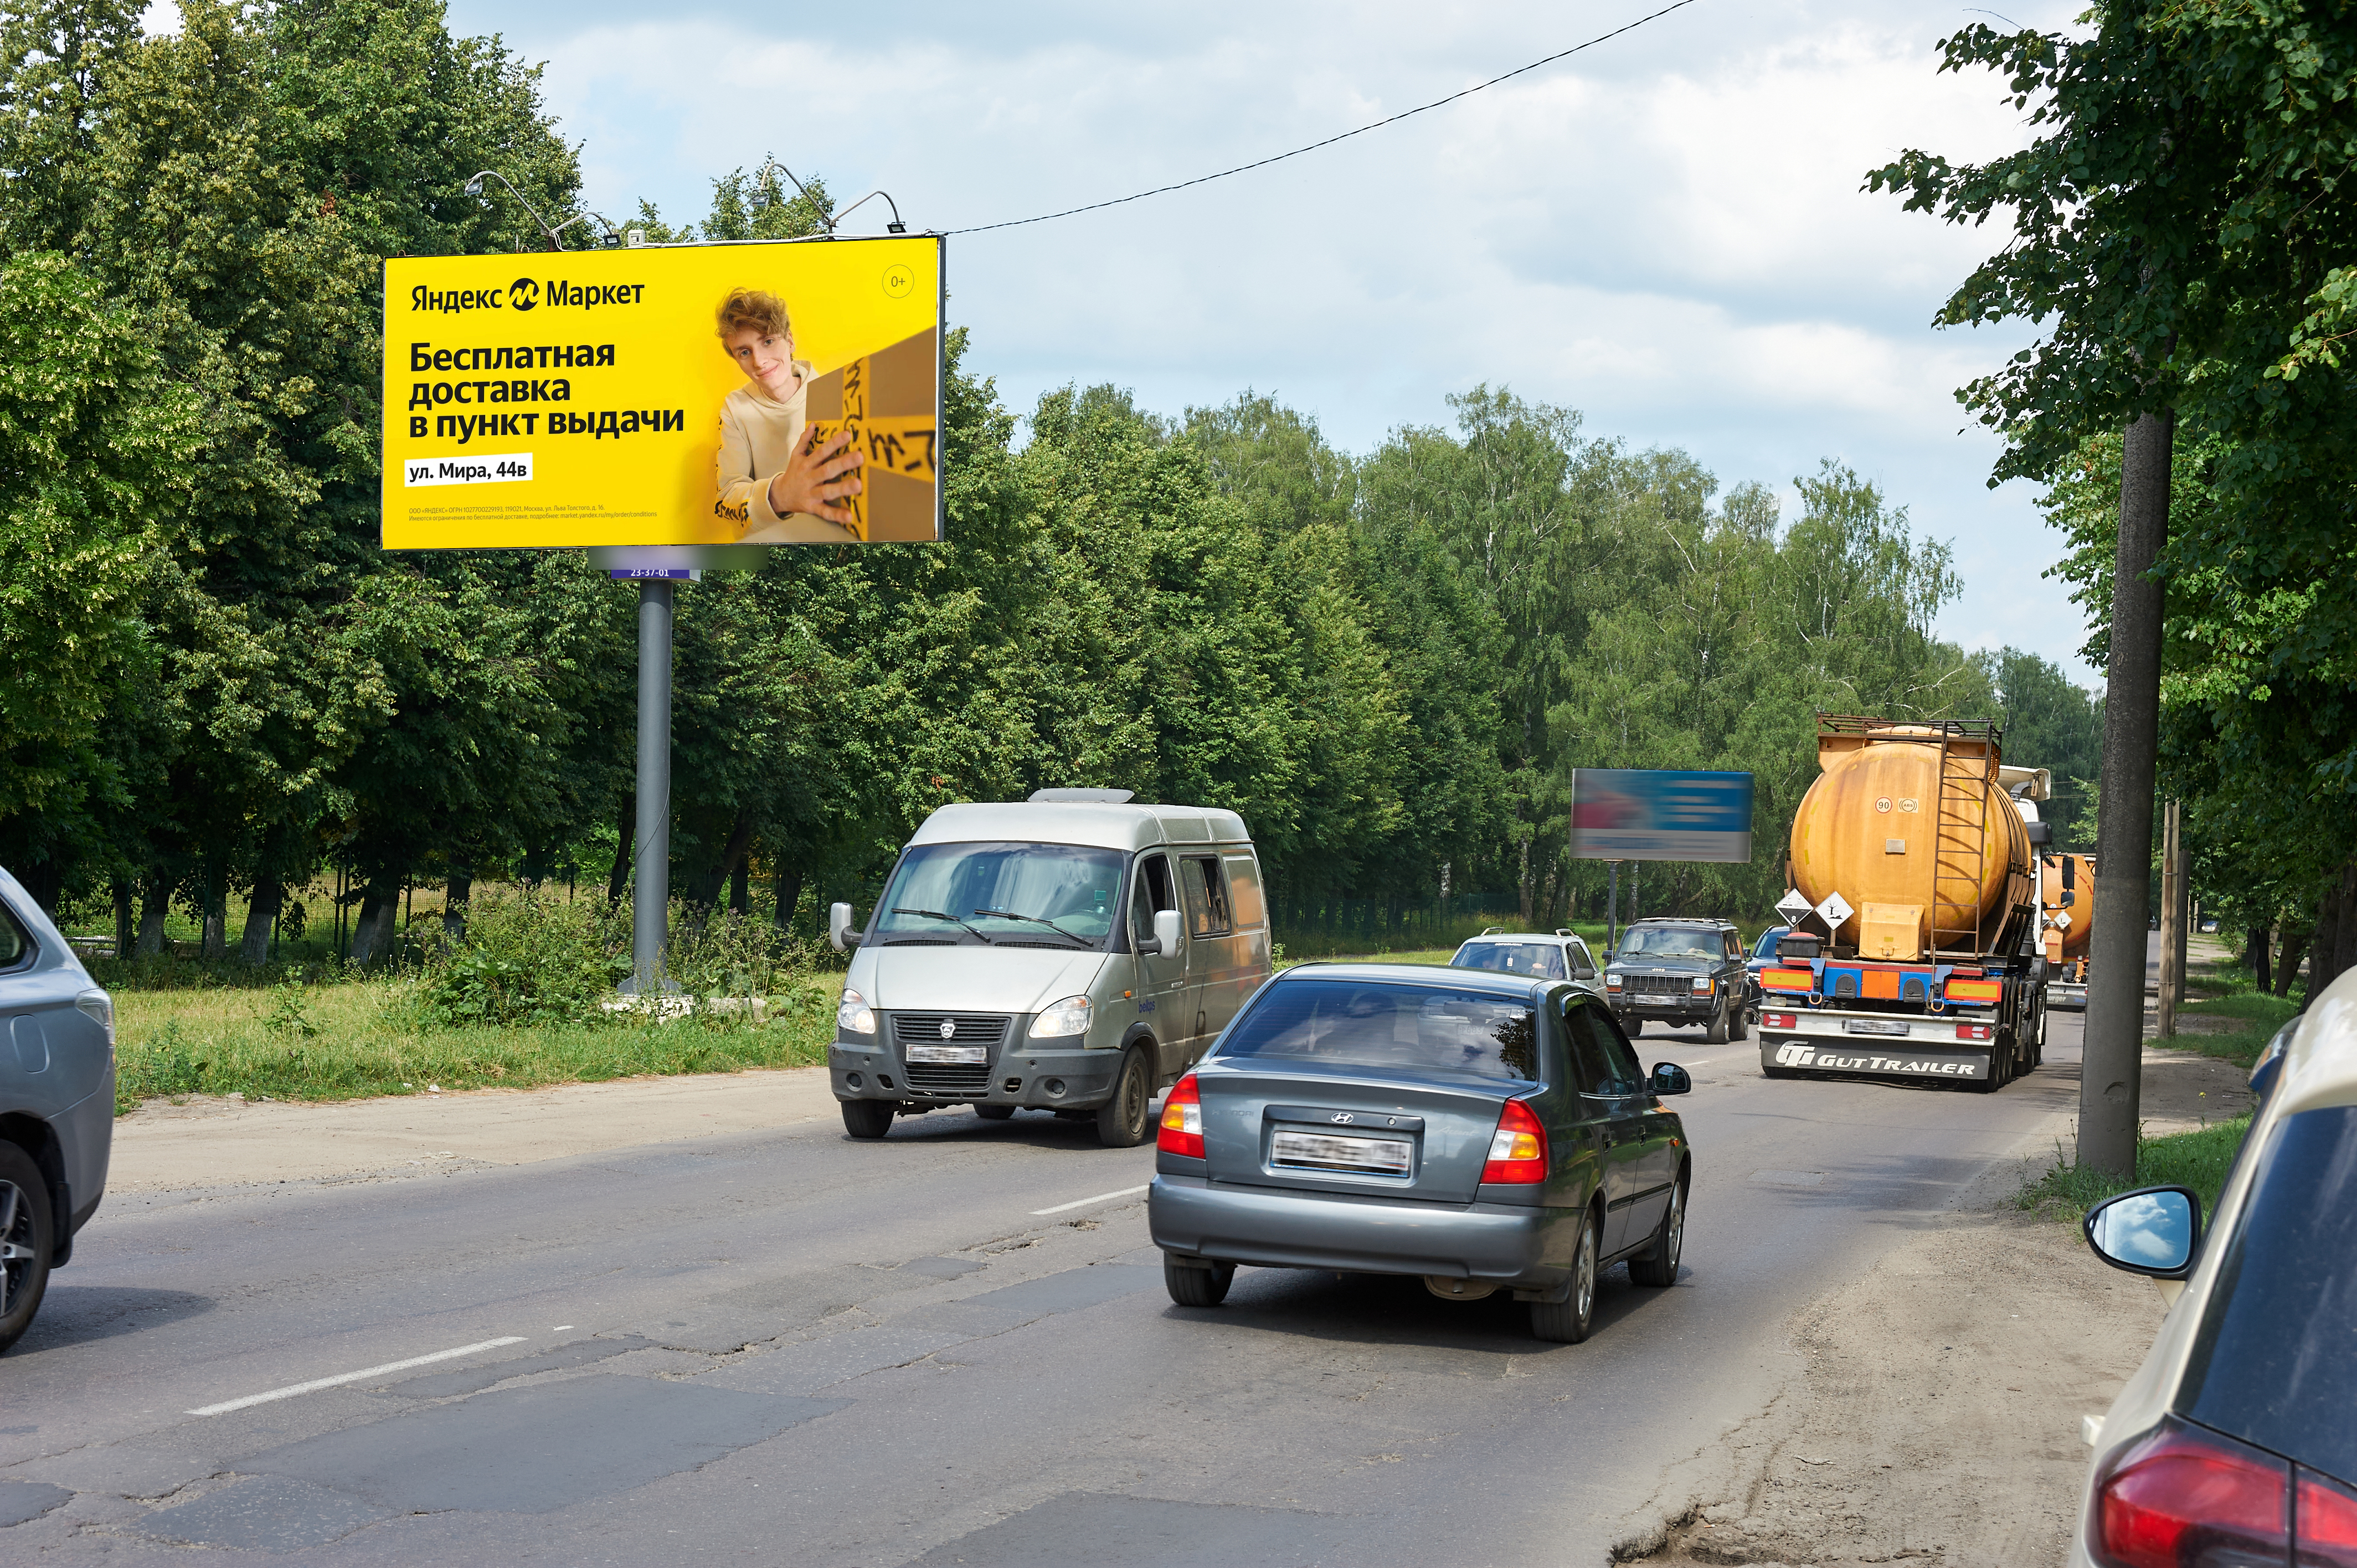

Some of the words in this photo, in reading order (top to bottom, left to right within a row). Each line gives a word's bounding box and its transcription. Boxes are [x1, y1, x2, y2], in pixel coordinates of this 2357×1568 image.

[411, 285, 502, 313] Яндекс
[547, 280, 645, 310] Маркет
[891, 276, 906, 287] 0+
[411, 342, 615, 372] Бесплатная
[409, 378, 570, 411] доставка
[410, 416, 428, 438] в
[436, 413, 539, 445] пункт
[548, 409, 684, 440] выдачи
[409, 467, 434, 483] ул.
[439, 462, 491, 481] Мира,
[496, 461, 527, 477] 44в
[560, 511, 657, 519] market.yandex.ru/my/order/conditions
